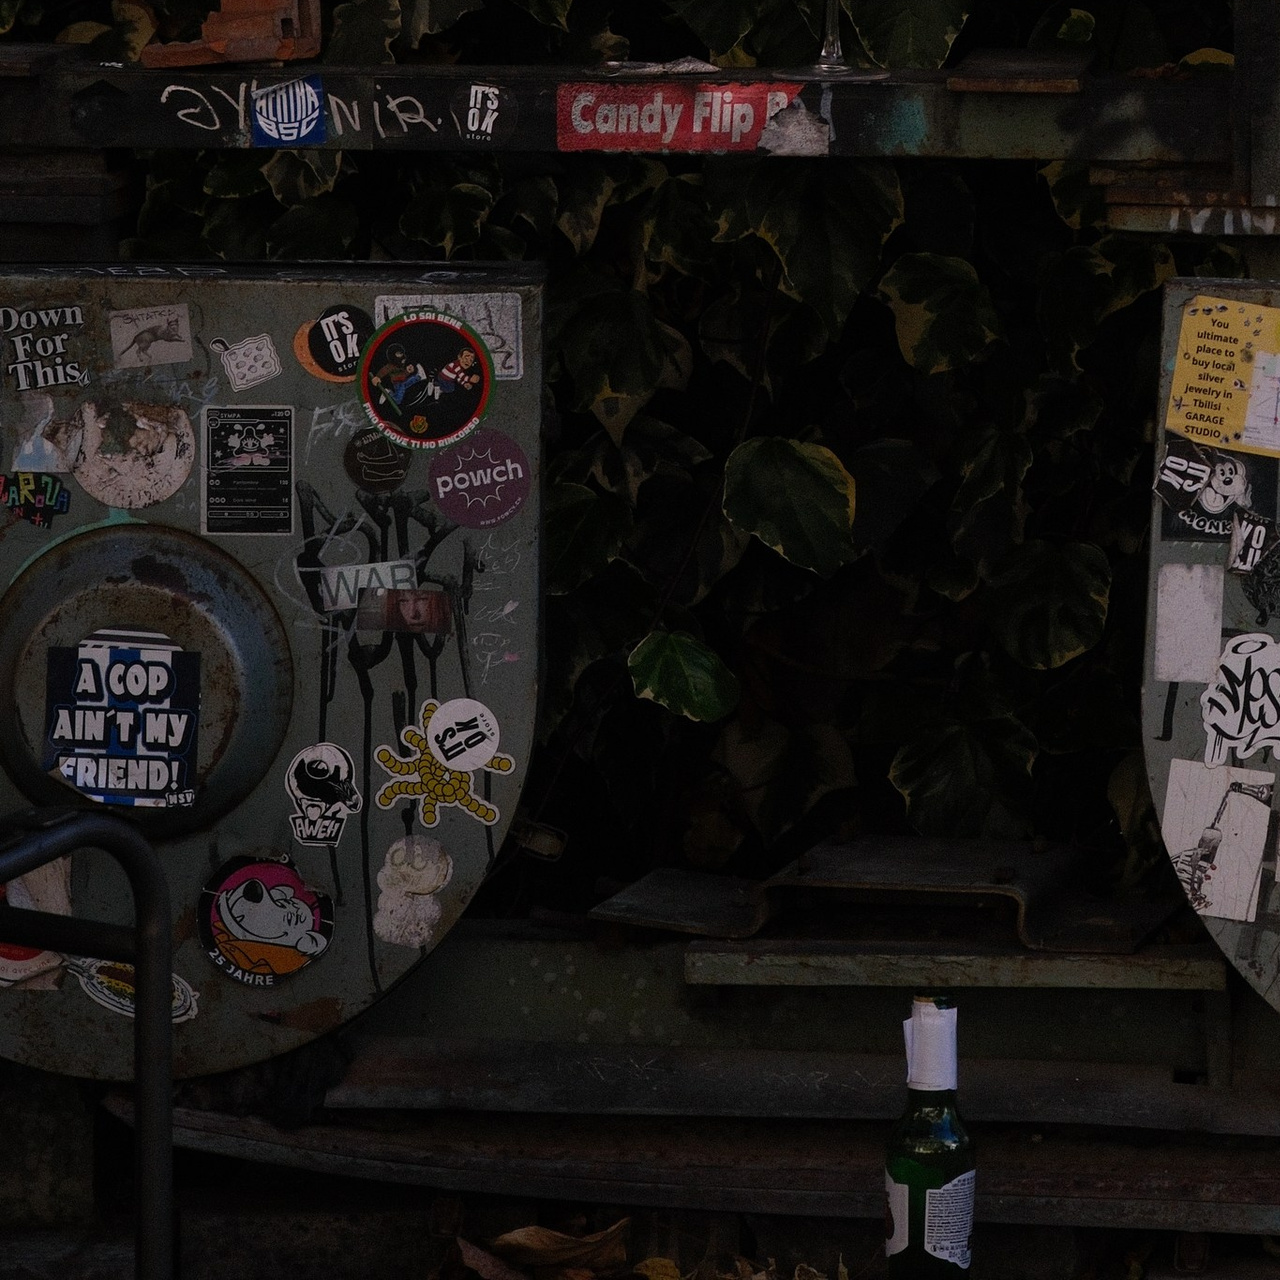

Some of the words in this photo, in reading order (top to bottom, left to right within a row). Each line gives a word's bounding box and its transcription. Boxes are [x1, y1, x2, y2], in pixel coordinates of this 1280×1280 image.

[255, 81, 320, 121] HERTHA
[468, 84, 500, 108] IT'S
[258, 109, 318, 141] BSC
[467, 108, 499, 133] OK
[572, 91, 677, 143] Candy
[691, 90, 751, 141] Flip
[466, 132, 491, 141] store
[0, 305, 84, 333] Down
[321, 311, 354, 341] IT'S
[419, 312, 435, 320] SAI
[1211, 319, 1229, 329] You
[11, 332, 68, 363] For
[1196, 344, 1222, 356] place
[1225, 349, 1235, 357] to
[1197, 331, 1239, 345] ultimate
[8, 356, 81, 390] This
[1192, 357, 1210, 369] buy
[1212, 360, 1235, 372] local
[1198, 372, 1225, 384] silver
[1184, 383, 1221, 399] jewelry
[1223, 390, 1233, 399] in
[1193, 399, 1221, 411] Tbilisi
[1185, 412, 1225, 425] GARAGE
[384, 428, 408, 447] DOVE
[411, 439, 420, 448] TI
[422, 440, 436, 449] HO
[438, 417, 480, 448] RINCORSO
[1184, 425, 1221, 438] STUDIO
[436, 458, 523, 499] powch
[76, 663, 97, 693] A
[109, 663, 168, 696] COP
[146, 713, 188, 747] MY
[432, 726, 465, 761] IT'S
[59, 757, 179, 790] FRIEND!
[167, 790, 195, 807] MSV
[297, 818, 340, 839] AWEH
[208, 948, 224, 965] 25
[226, 964, 274, 986] JAHRE
